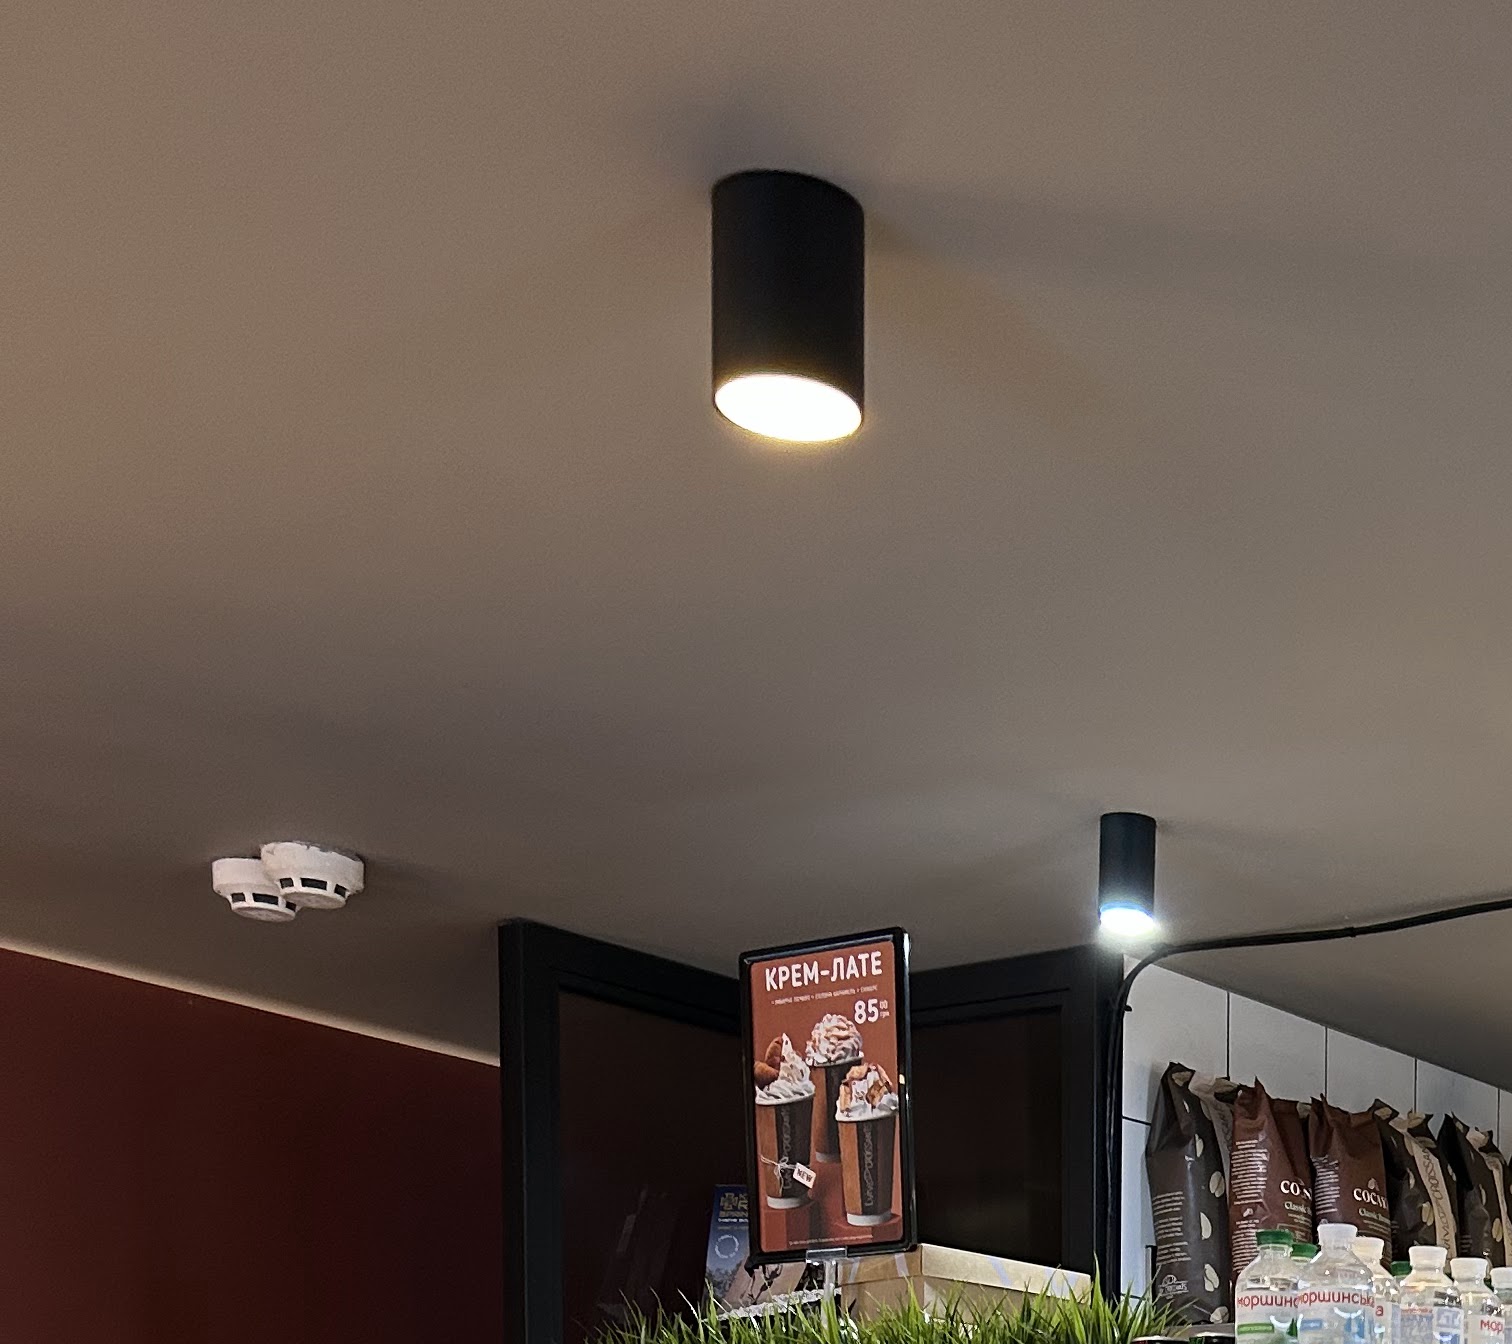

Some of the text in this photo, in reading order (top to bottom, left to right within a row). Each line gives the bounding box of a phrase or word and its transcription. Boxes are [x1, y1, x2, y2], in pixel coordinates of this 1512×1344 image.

[766, 951, 882, 991] КРЕМ-ЛАТЕ
[855, 999, 879, 1024] 85
[797, 1167, 813, 1183] NEW
